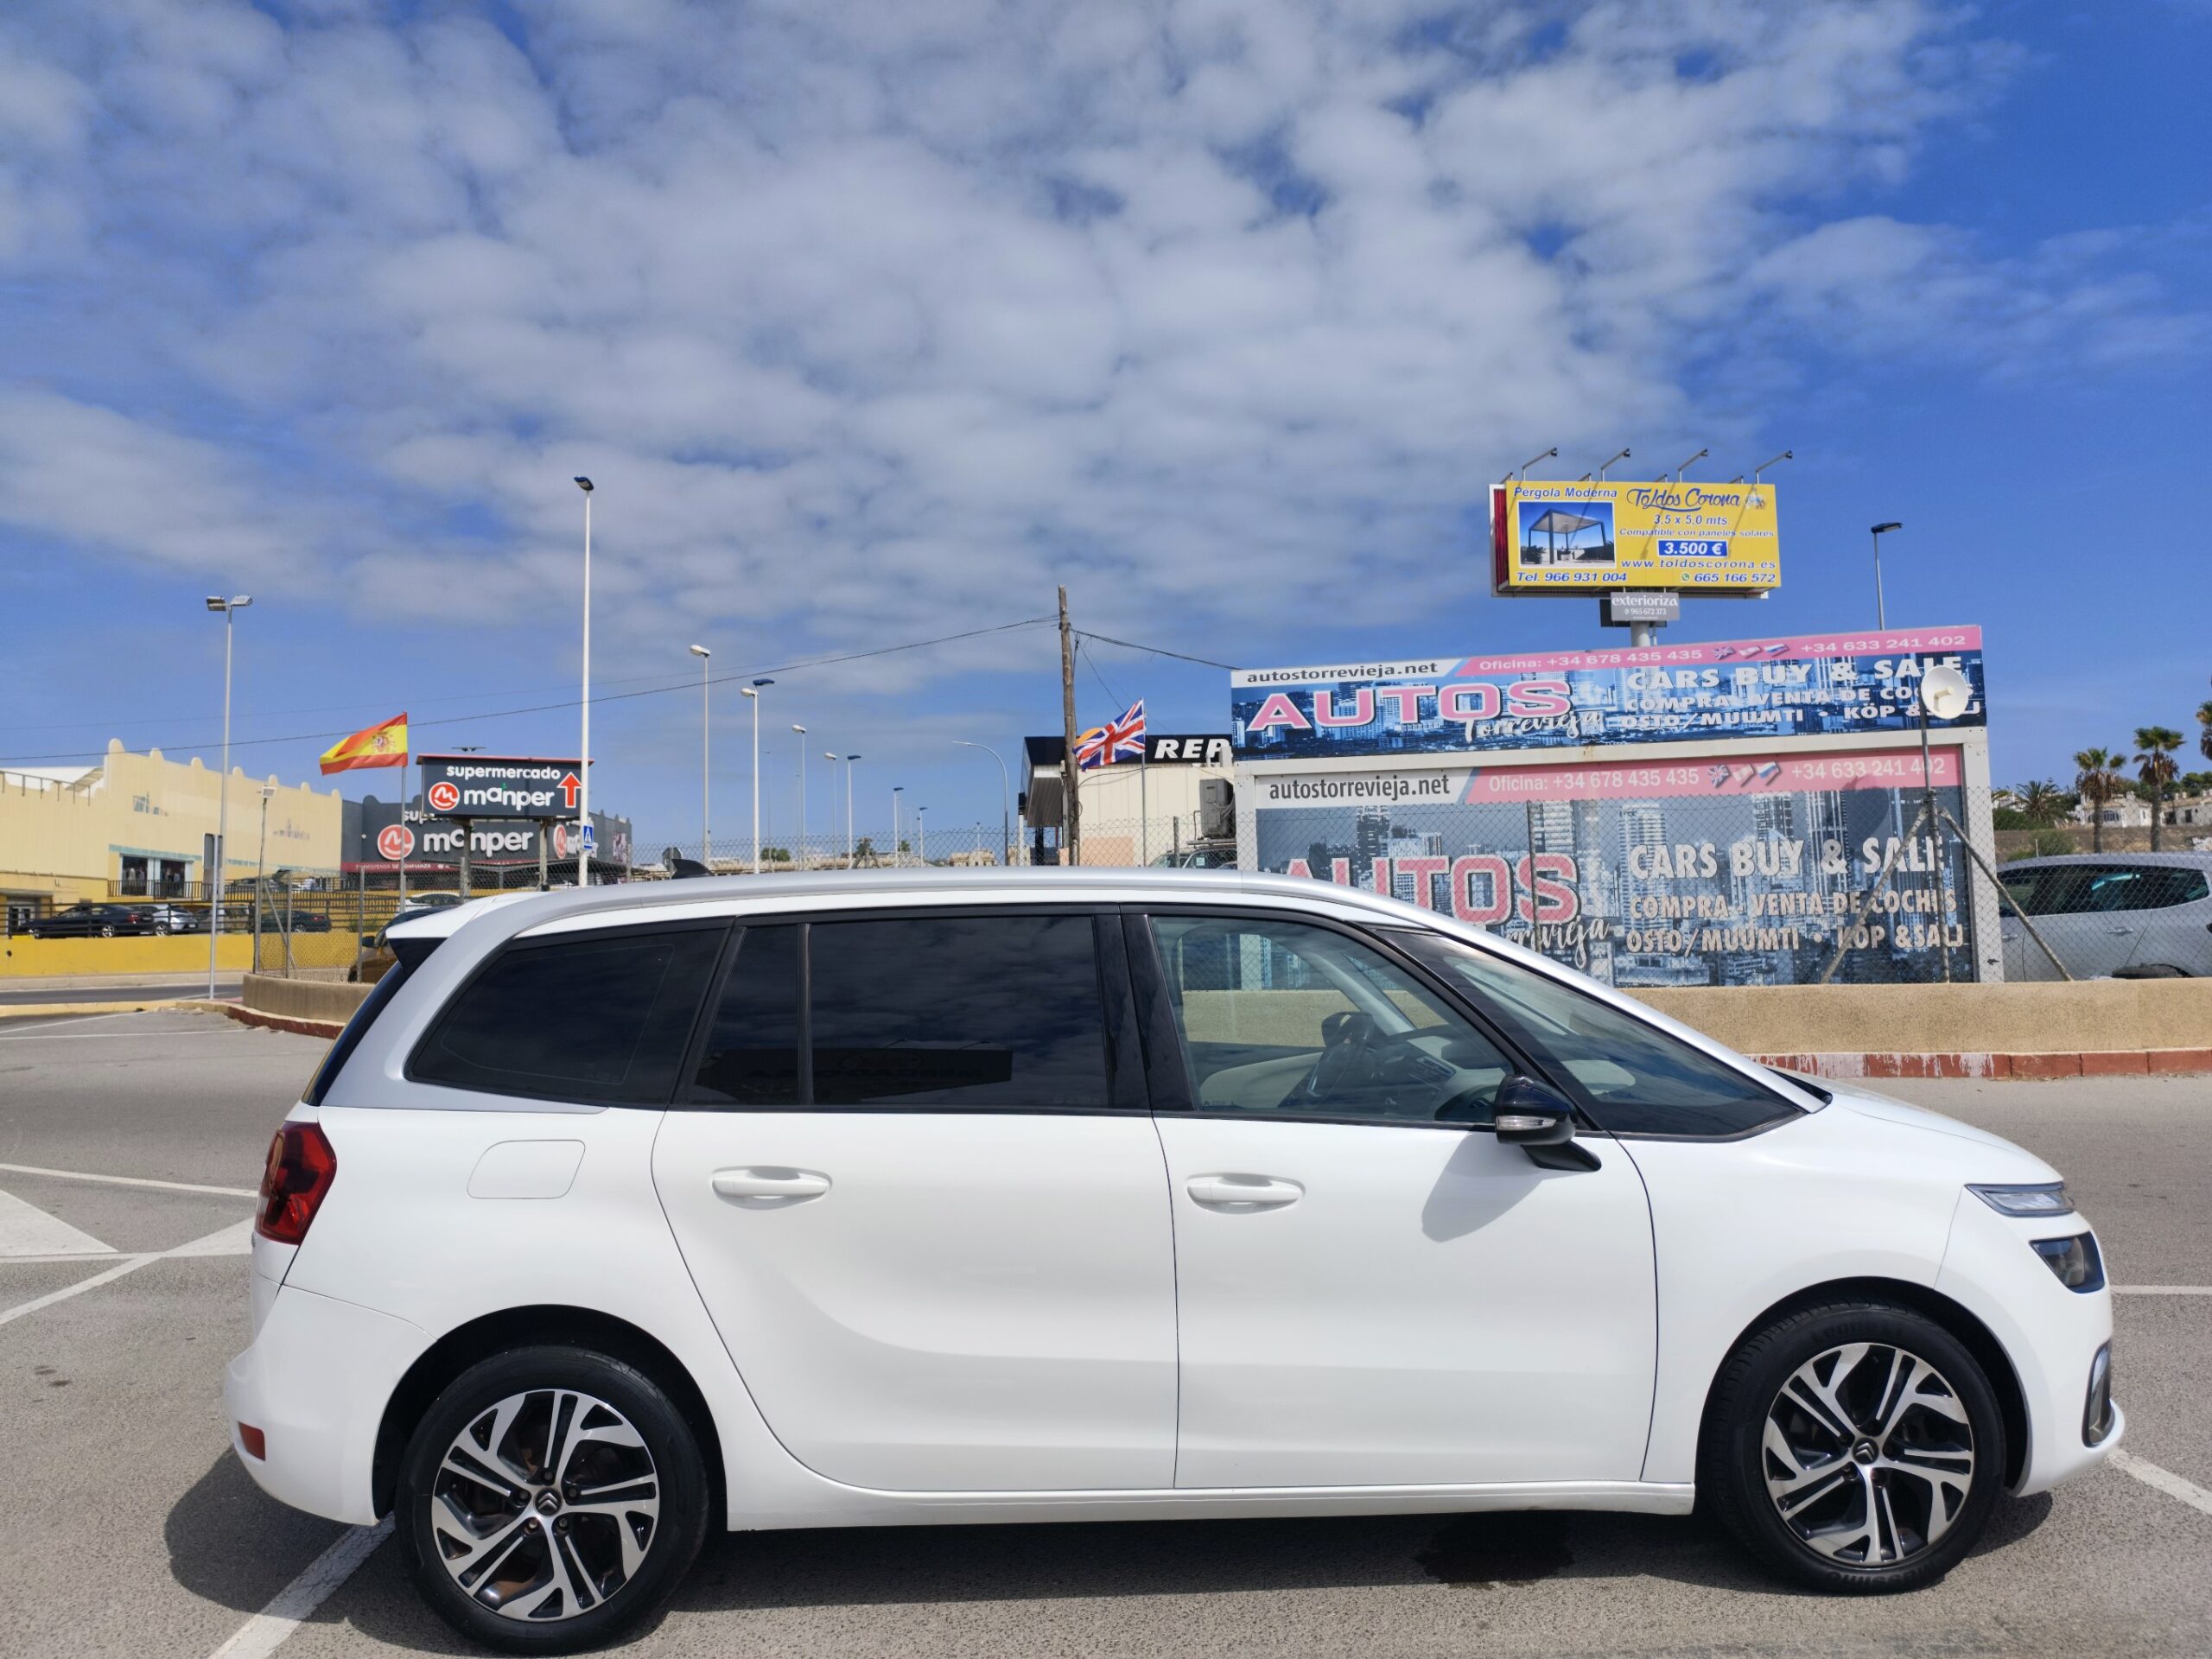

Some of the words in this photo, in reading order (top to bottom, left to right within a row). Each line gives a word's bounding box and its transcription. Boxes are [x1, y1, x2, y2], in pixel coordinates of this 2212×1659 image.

[1565, 487, 1618, 498] Moderna
[1685, 487, 1740, 507] Corona
[1619, 528, 1675, 537] Compatible
[1699, 529, 1736, 537] paneles
[1664, 543, 1708, 555] 3.500
[1712, 543, 1723, 555] €
[1621, 560, 1776, 569] www.toldoscorona.es
[1517, 572, 1540, 582] Tel.
[1545, 573, 1570, 582] 966
[1573, 573, 1598, 582] 931
[1602, 573, 1627, 582] 004
[1694, 573, 1719, 582] 665
[1725, 573, 1747, 582] 166
[1751, 574, 1776, 582] 572
[1611, 595, 1678, 607] exterioriza
[1802, 642, 1837, 653] +34
[1843, 640, 1879, 651] 633
[1886, 638, 1923, 649] 241
[1929, 635, 1966, 646] 402
[1479, 659, 1542, 671] Oficina:
[1548, 656, 1581, 666] +34
[1586, 653, 1621, 664] 678
[1627, 652, 1662, 663] 435
[1667, 650, 1702, 660] 435
[1248, 662, 1438, 683] autostorrevieja.net
[1627, 668, 1720, 690] CARS
[1735, 664, 1813, 686] BUY
[1830, 662, 1859, 682] &
[1246, 680, 1573, 732] AUTOS
[1626, 695, 1734, 711] COMPRA
[1753, 689, 1831, 706] VENTA
[1840, 688, 1871, 702] DE
[1844, 703, 1896, 721] KÖP
[1462, 711, 1601, 743] Torrevieja
[446, 766, 561, 780] supermercado
[1490, 775, 1548, 792] Oficina:
[1553, 774, 1585, 789] +34
[1591, 771, 1623, 789] 678
[1628, 769, 1661, 787] 435
[1666, 767, 1700, 786] 435
[1791, 763, 1827, 781] +34
[1831, 761, 1866, 779] 633
[1871, 760, 1906, 777] 241
[1269, 775, 1450, 801] autostorrevieja.net
[464, 787, 555, 811] manper
[1630, 843, 1719, 880] CARS
[1731, 840, 1804, 877] BUY
[1821, 839, 1848, 874] &
[1630, 894, 1728, 919] COMPRA
[1751, 892, 1824, 916] VENTA
[1833, 892, 1862, 915] DE
